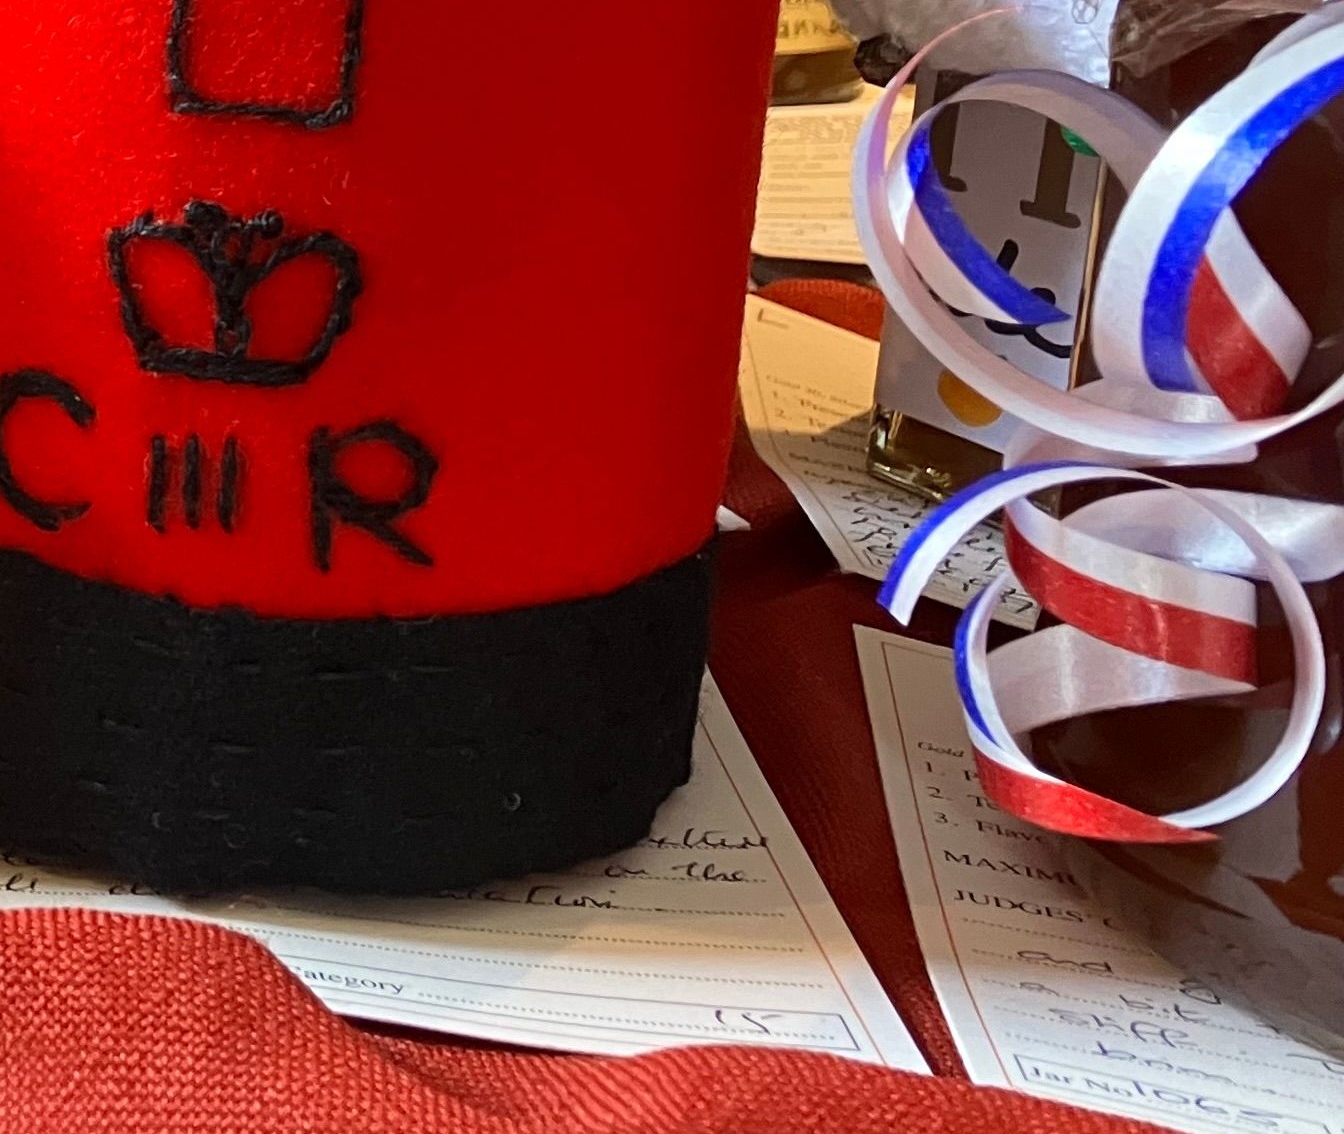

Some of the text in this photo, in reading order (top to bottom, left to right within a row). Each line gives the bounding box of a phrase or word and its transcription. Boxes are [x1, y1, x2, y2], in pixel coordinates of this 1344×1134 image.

[308, 420, 439, 574] R
[918, 741, 964, 758] Gold
[1030, 1065, 1074, 1086] Jar
[1086, 1077, 1132, 1098] No
